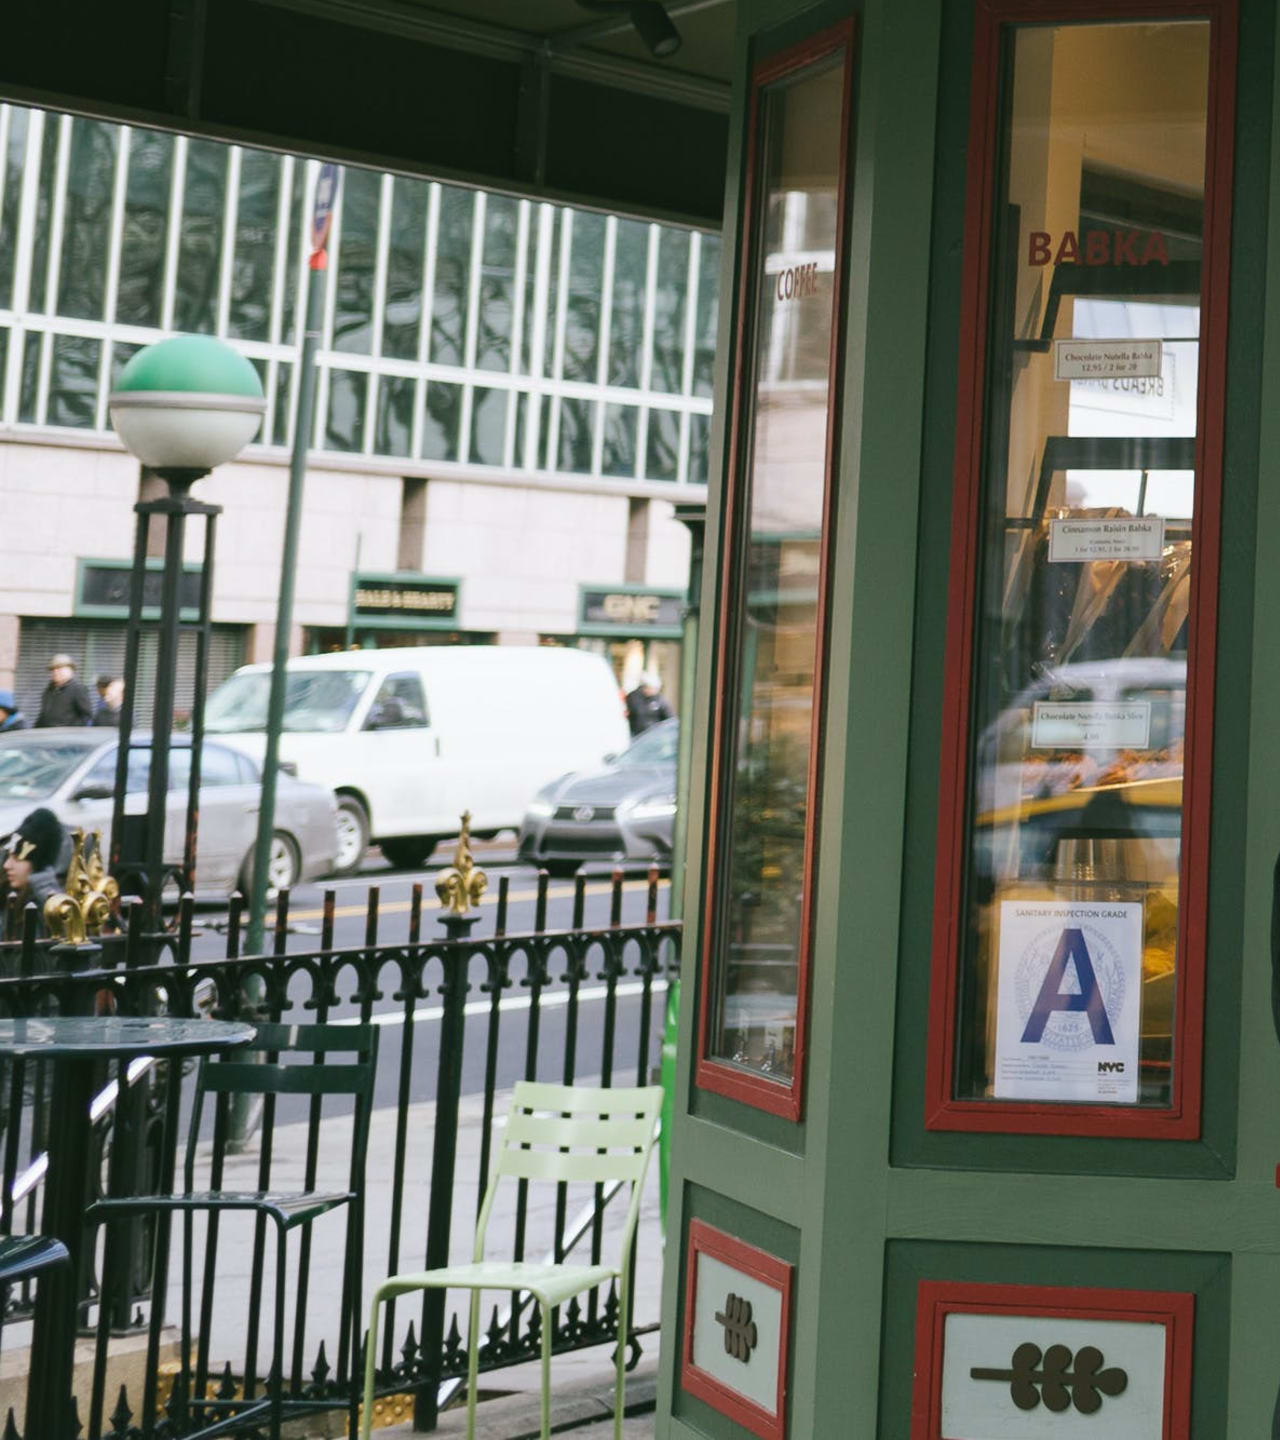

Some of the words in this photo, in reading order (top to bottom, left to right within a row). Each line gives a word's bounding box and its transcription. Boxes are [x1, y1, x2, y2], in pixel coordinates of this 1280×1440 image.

[1027, 230, 1169, 266] BABKA
[777, 262, 818, 301] COFFEE
[1054, 910, 1100, 919] INSPECTION
[1101, 910, 1128, 919] GRADE
[1020, 928, 1116, 1045] A
[1097, 1061, 1125, 1073] NYC
